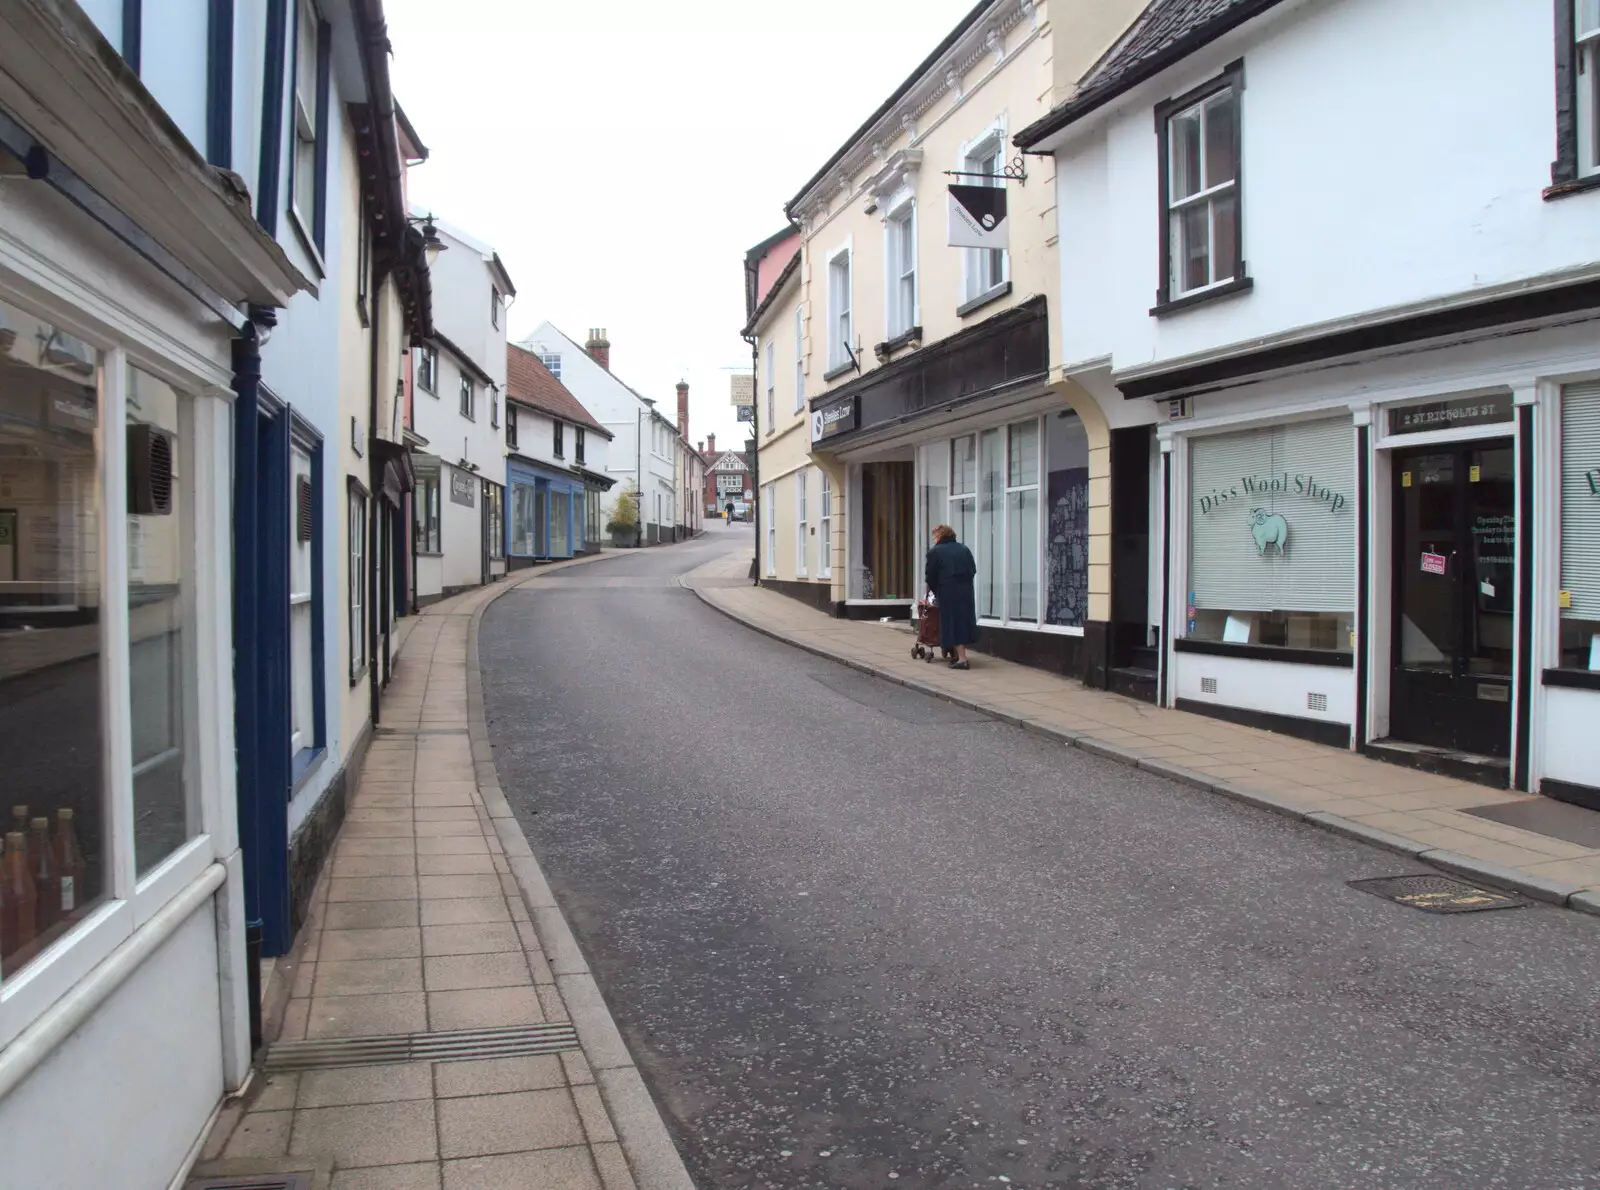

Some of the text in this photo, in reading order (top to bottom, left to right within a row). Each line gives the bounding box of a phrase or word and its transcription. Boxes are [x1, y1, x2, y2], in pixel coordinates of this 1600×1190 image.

[1200, 472, 1345, 514] Diss Wool Shop
[1422, 562, 1443, 572] CLOSED
